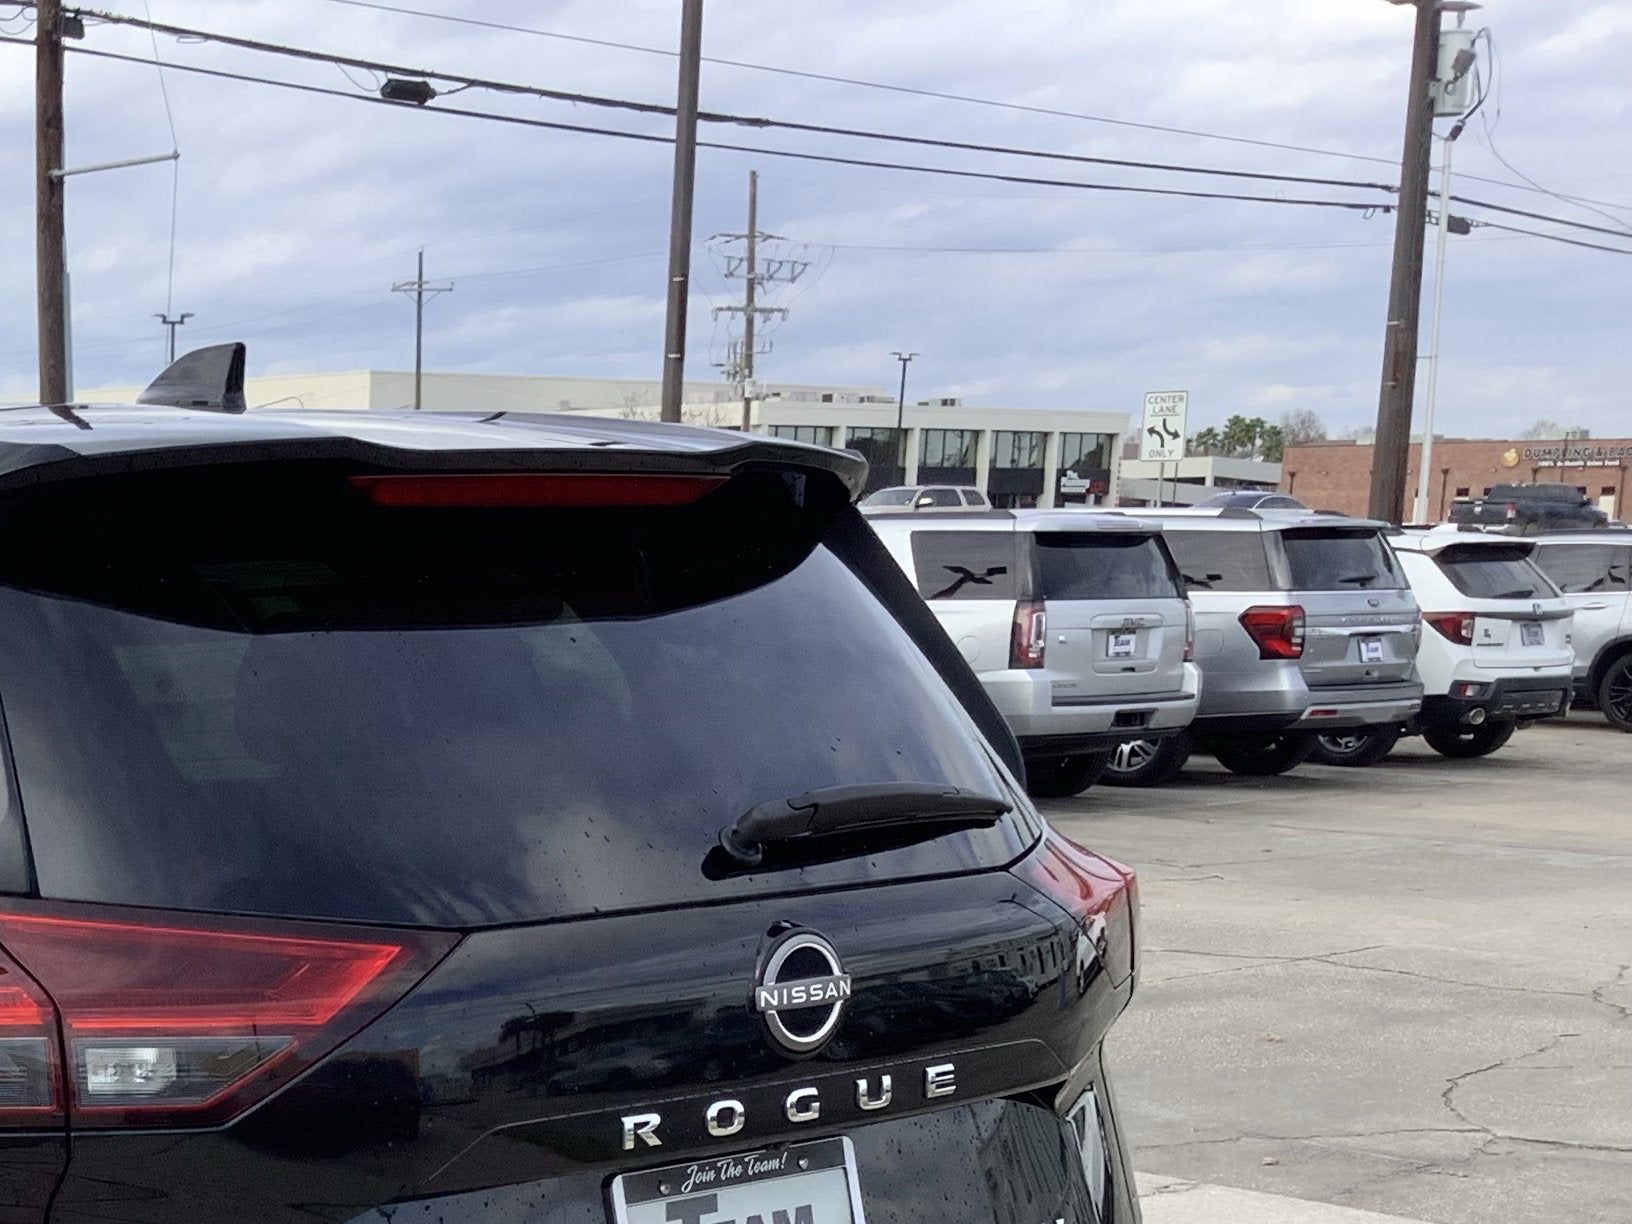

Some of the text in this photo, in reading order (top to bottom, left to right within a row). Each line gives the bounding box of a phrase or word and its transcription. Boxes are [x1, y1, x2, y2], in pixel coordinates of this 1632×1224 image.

[1148, 394, 1184, 405] CENTER
[1153, 404, 1177, 414] LANE
[1149, 449, 1174, 458] ONLY
[760, 979, 851, 1008] NISSAN
[621, 1063, 957, 1151] ROGUE
[680, 1151, 789, 1194] Join The Team!
